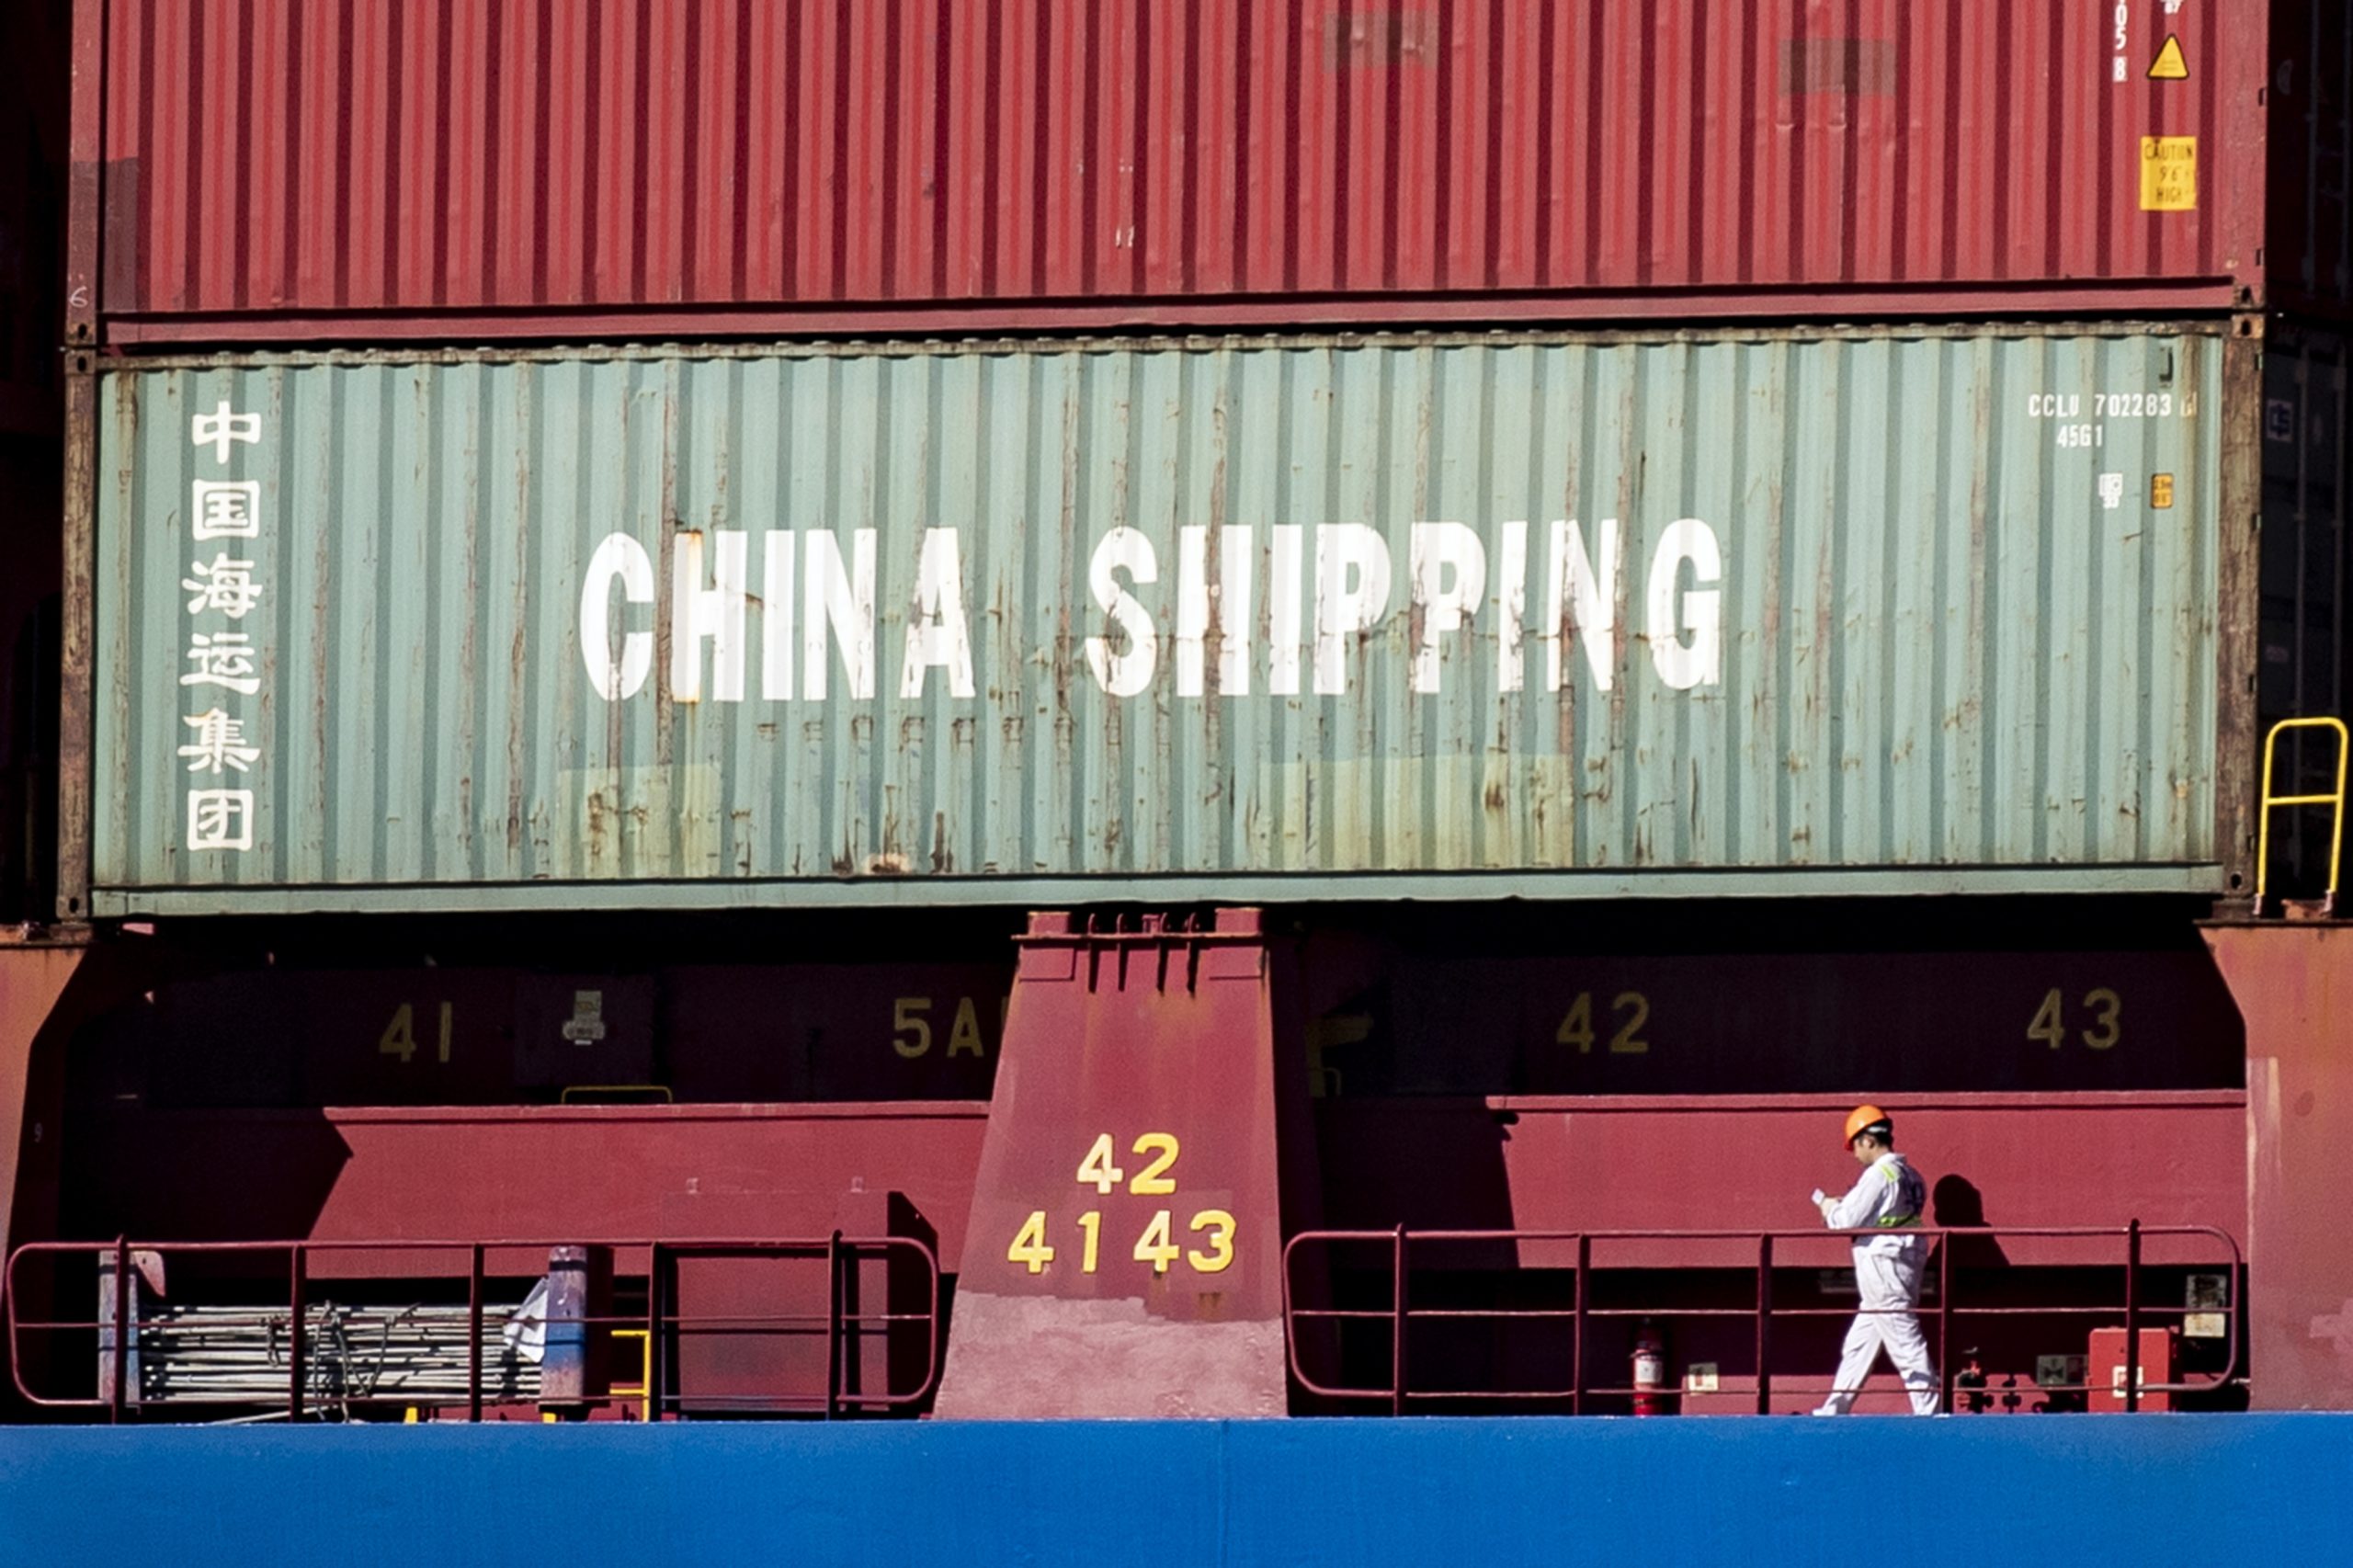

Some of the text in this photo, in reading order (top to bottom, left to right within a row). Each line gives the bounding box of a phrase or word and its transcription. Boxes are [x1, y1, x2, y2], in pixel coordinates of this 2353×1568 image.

[2114, 0, 2129, 51] 05
[2027, 393, 2080, 418] CCLU
[2093, 392, 2173, 418] 702283
[2055, 424, 2104, 449] 45G1
[177, 400, 263, 852] 中国海运集团
[579, 517, 1722, 703] CHINA SHIPPING
[379, 1000, 453, 1064] 41
[1555, 990, 1652, 1054] 42
[2025, 987, 2123, 1052] 43
[1076, 1132, 1180, 1195] 42
[1007, 1209, 1237, 1273] 41 43
